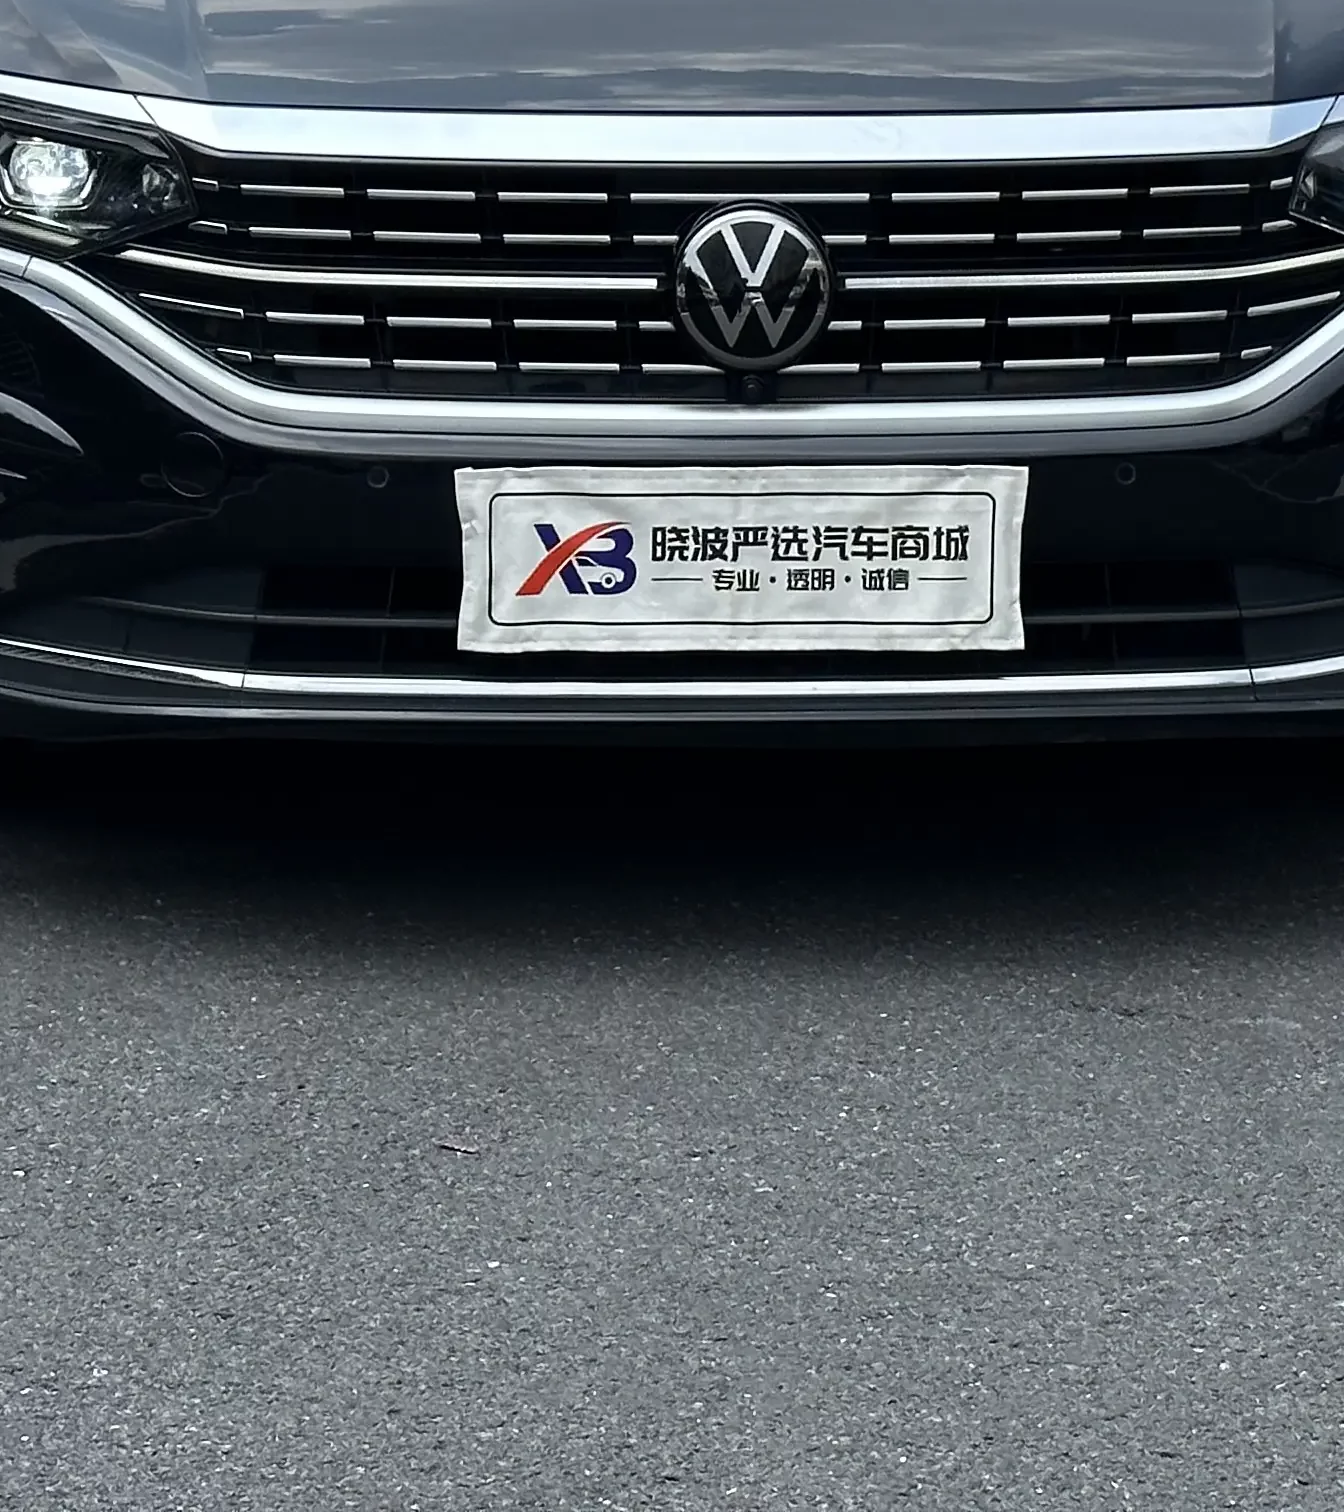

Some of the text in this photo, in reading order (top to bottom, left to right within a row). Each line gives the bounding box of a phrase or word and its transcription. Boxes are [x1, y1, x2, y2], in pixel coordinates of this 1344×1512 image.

[650, 524, 972, 563] 晓波严选汽车商城
